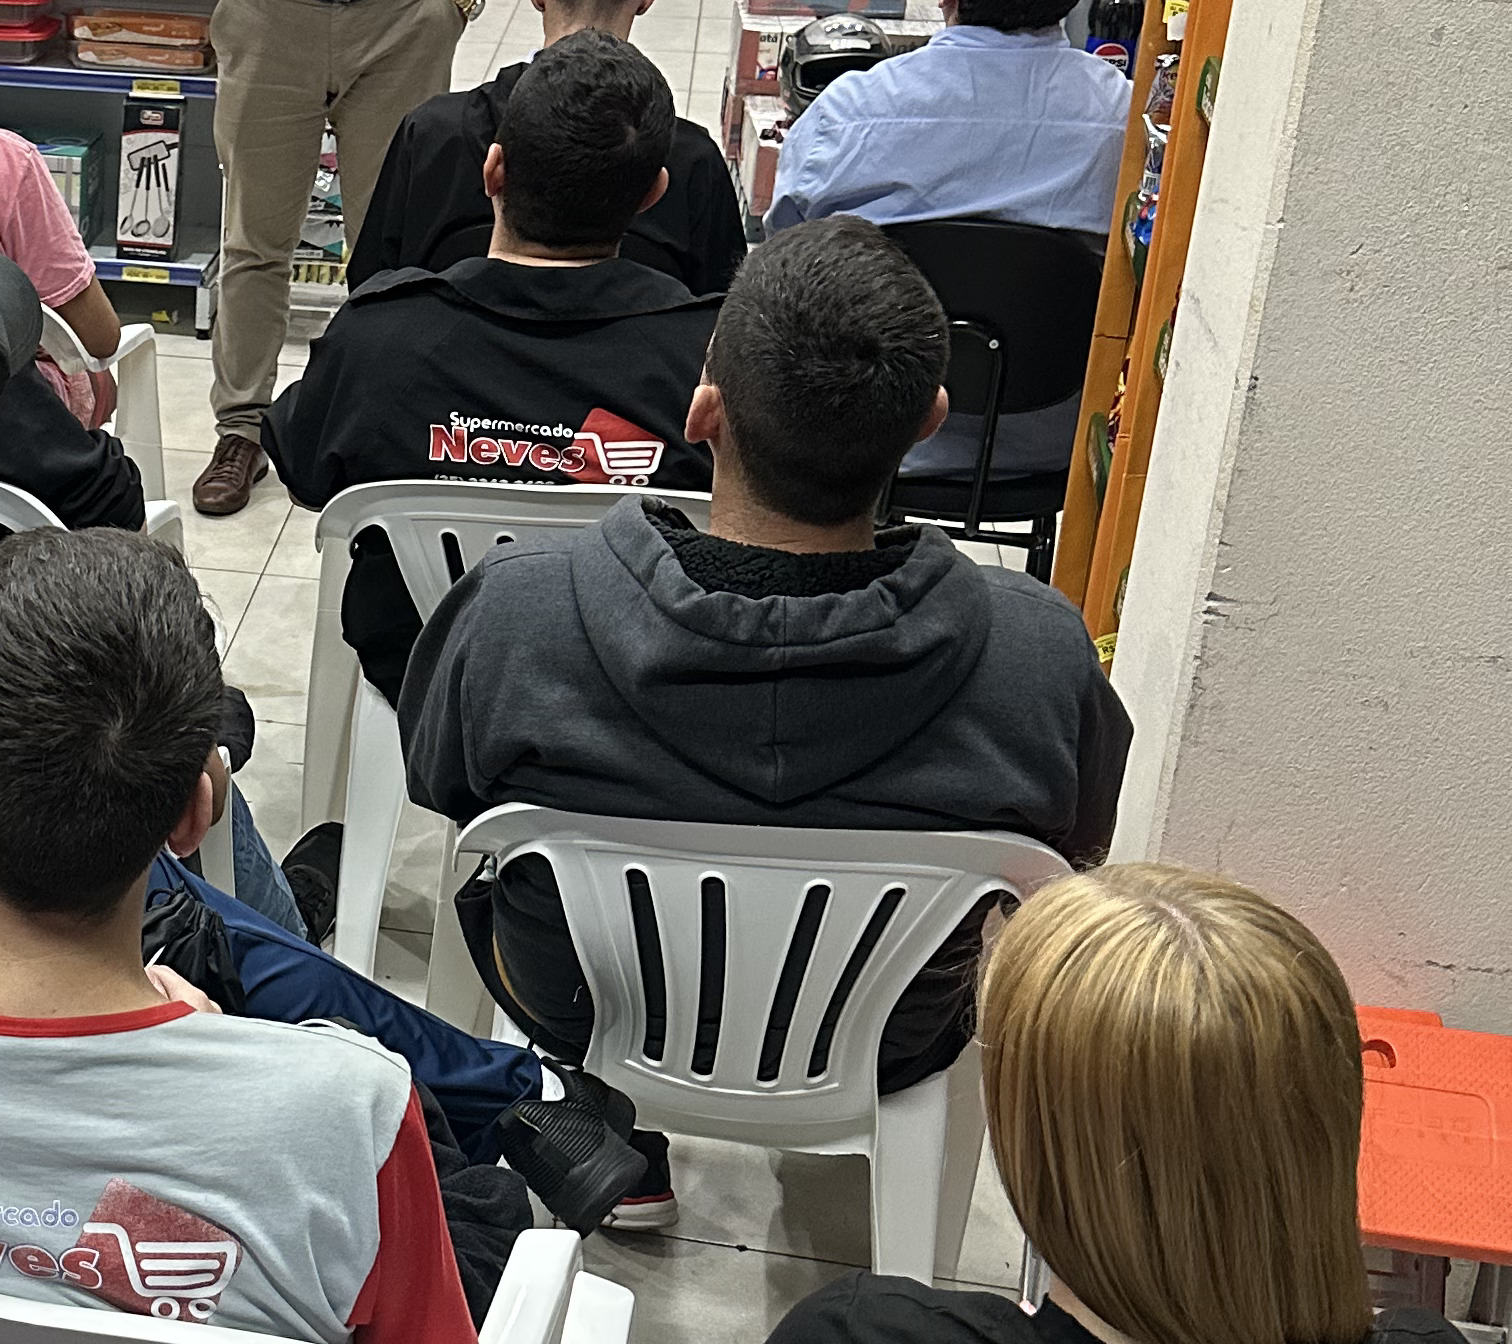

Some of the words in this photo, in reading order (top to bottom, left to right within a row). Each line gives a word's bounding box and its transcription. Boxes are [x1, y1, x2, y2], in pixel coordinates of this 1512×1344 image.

[759, 32, 778, 43] atá
[449, 411, 574, 439] Supermercado
[428, 424, 586, 473] Neves
